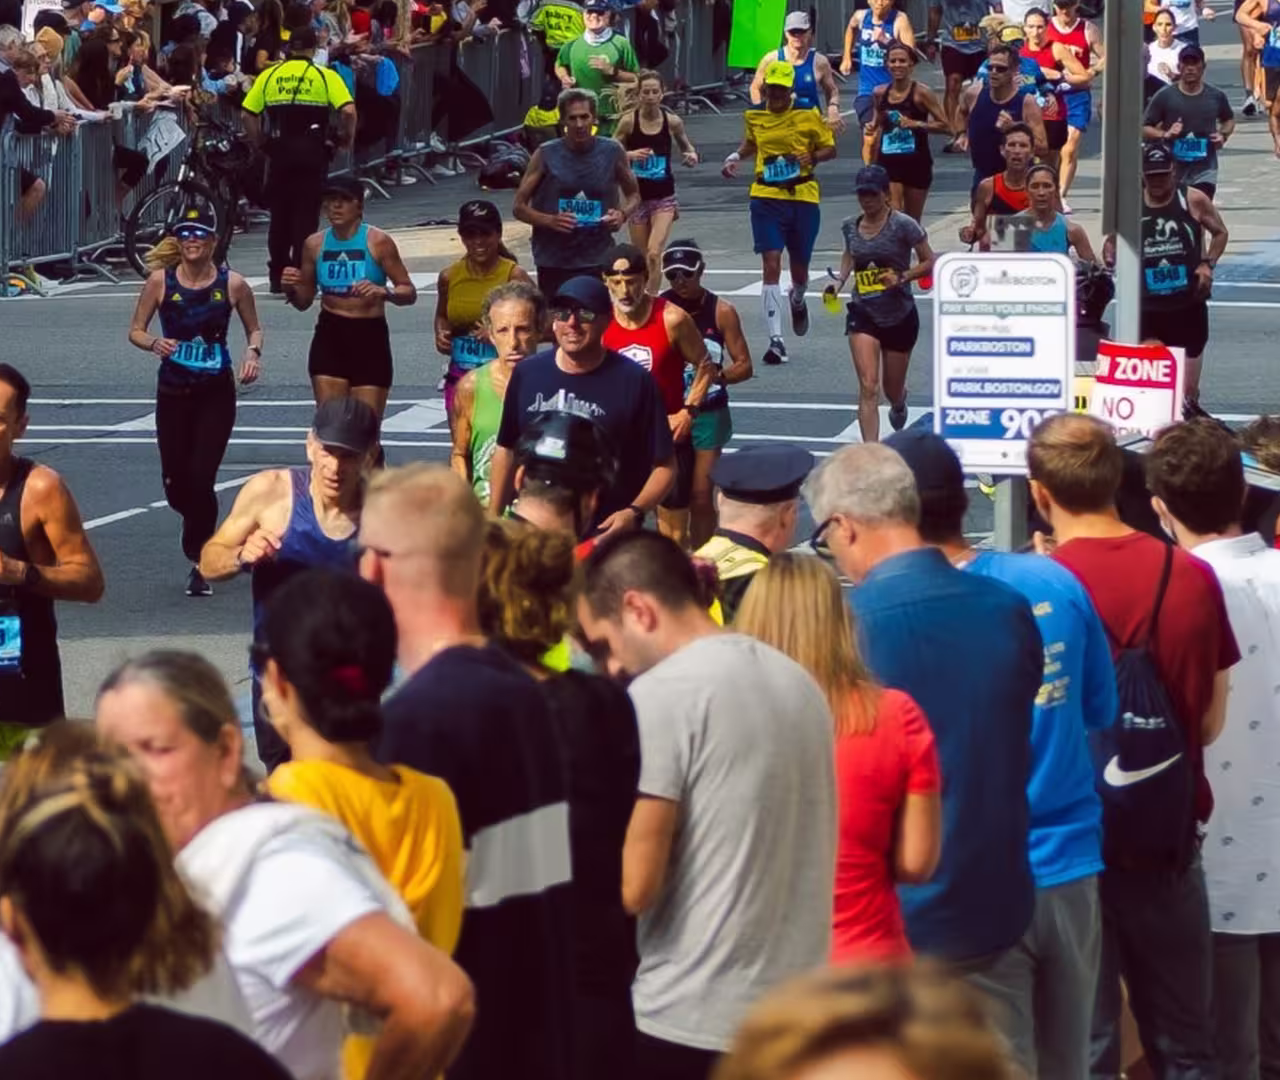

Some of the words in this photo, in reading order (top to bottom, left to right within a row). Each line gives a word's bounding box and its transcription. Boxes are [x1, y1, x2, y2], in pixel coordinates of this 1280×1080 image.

[942, 303, 963, 314] PAY
[965, 303, 994, 314] WITH
[996, 303, 1025, 314] YOUR
[1026, 303, 1063, 314] PHONE
[950, 340, 1032, 353] PARKBOSTON
[1114, 356, 1172, 383] ZONE
[950, 381, 1060, 394] PARK.BOSTON.GOV
[1103, 397, 1135, 420] NO
[945, 408, 992, 426] ZONE
[1001, 407, 1058, 439] 90
